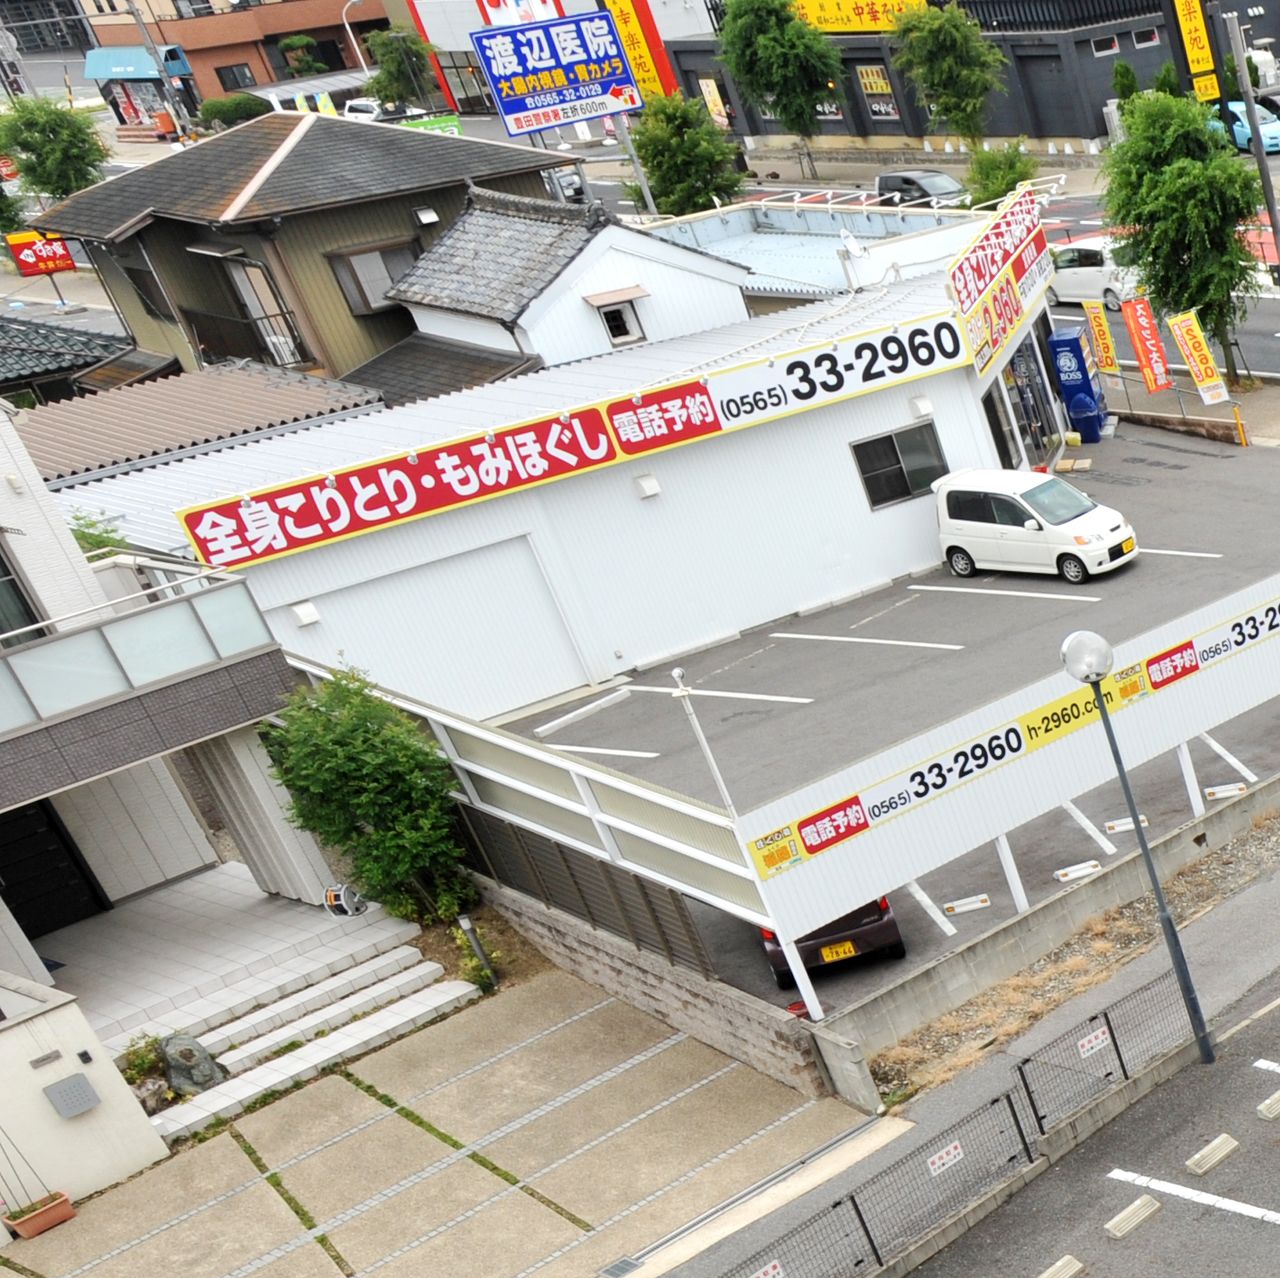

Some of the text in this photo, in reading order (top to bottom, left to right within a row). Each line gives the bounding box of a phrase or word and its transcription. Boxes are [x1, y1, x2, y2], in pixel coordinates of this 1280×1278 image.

[482, 19, 618, 77] 渡辺医院
[616, 8, 651, 74] 幸楽苑
[535, 84, 602, 107] 0565-32-0129
[1060, 371, 1082, 381] BOSS
[195, 321, 961, 566] 全身こりとり・もみほぐし 電話予約 (0565) 33-2960
[801, 804, 865, 847] 電話予約
[868, 790, 912, 822] (0565)
[909, 727, 1023, 798] 33-2960
[1148, 647, 1198, 684] 電話予約
[1199, 638, 1232, 663] (0565)
